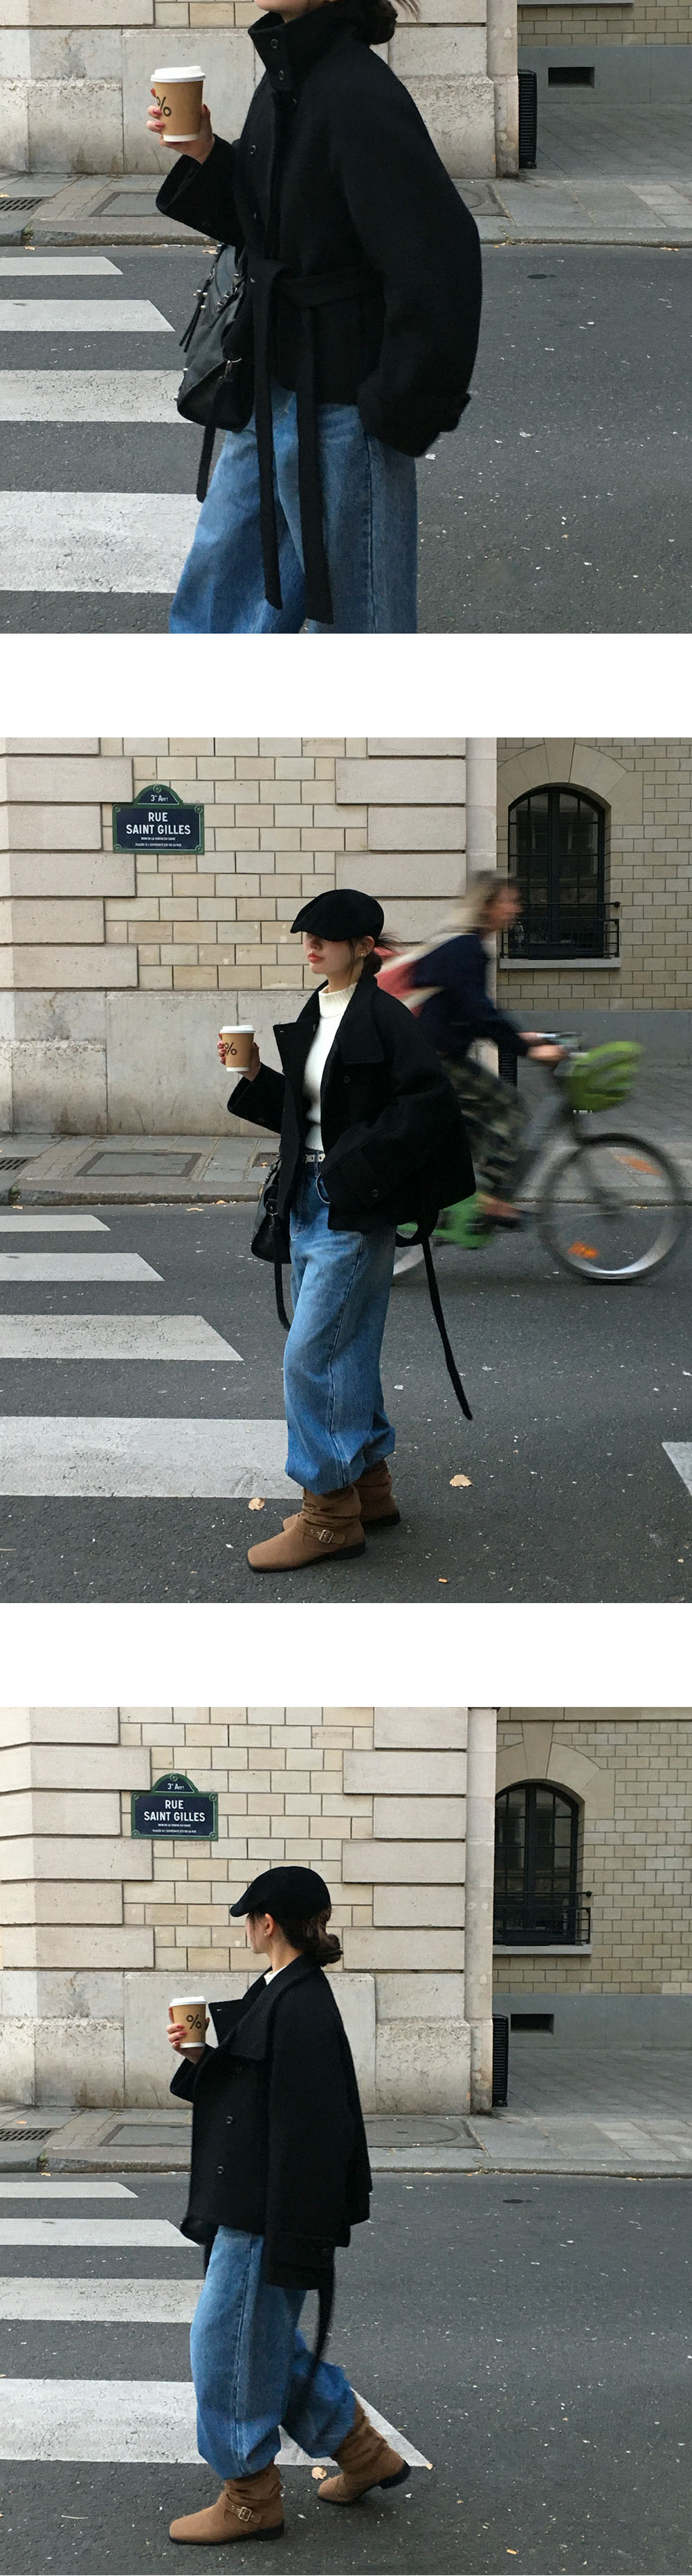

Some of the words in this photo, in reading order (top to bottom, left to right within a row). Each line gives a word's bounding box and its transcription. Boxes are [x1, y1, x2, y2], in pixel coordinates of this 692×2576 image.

[148, 812, 168, 822] RUE
[126, 824, 154, 834] SAINT
[157, 825, 191, 835] GILLES
[225, 1042, 237, 1055] %
[165, 1800, 184, 1809] RUE
[144, 1811, 171, 1821] SAINT
[174, 1812, 206, 1822] GILLES
[186, 2014, 201, 2030] %
